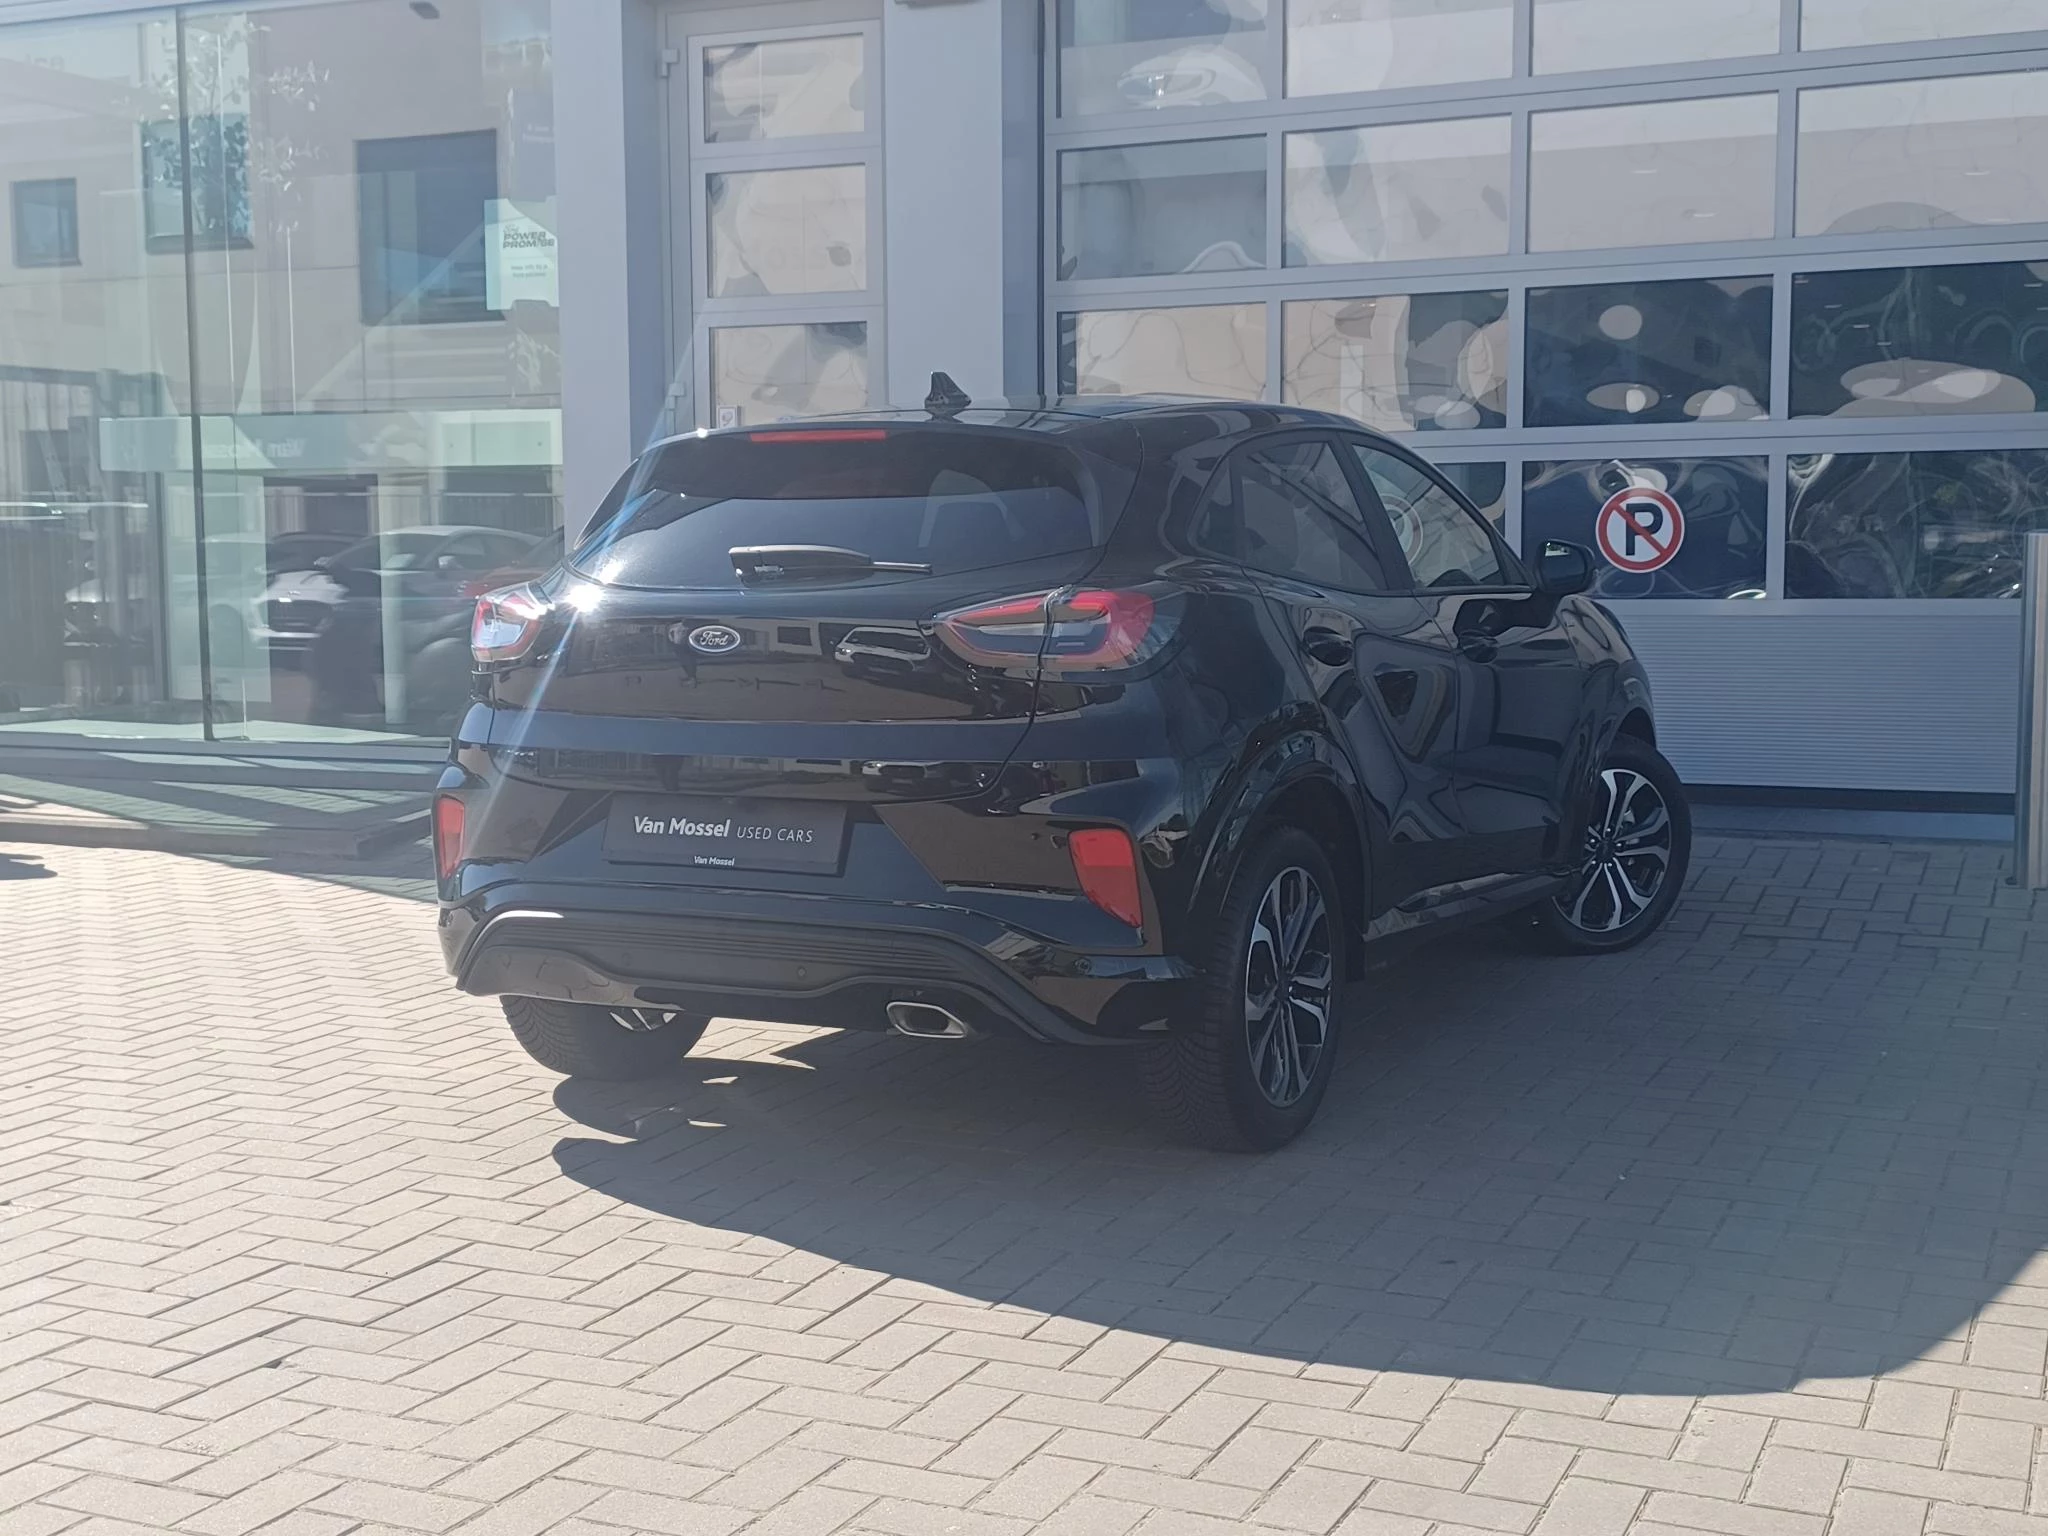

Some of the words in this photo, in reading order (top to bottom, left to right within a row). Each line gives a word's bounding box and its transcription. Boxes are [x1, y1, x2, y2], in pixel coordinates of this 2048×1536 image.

[1625, 502, 1664, 556] P
[634, 815, 665, 835] Van
[668, 817, 731, 838] Mossel
[736, 826, 772, 840] USED
[777, 828, 814, 843] CARS
[694, 855, 708, 865] Van
[708, 856, 735, 867] Mossel
